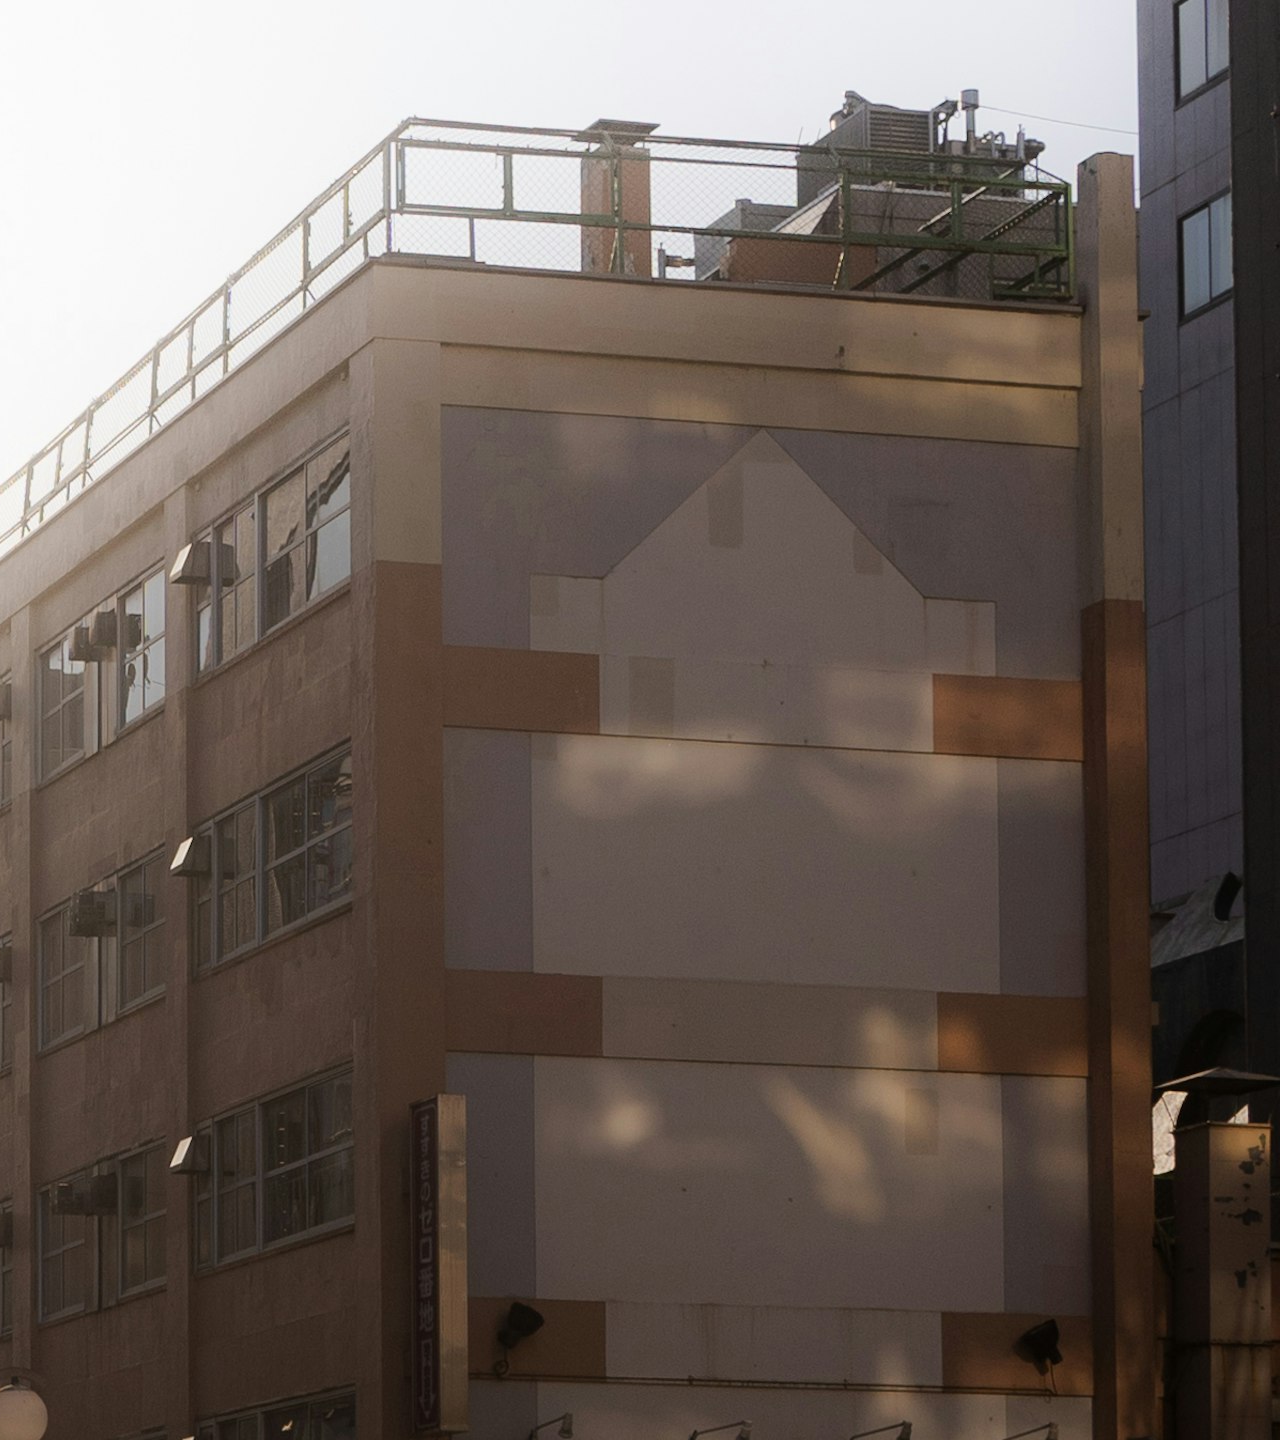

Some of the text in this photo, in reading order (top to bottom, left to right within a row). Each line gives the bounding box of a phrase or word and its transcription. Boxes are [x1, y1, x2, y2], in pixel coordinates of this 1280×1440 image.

[418, 1114, 434, 1333] すすきのゼロ番地
